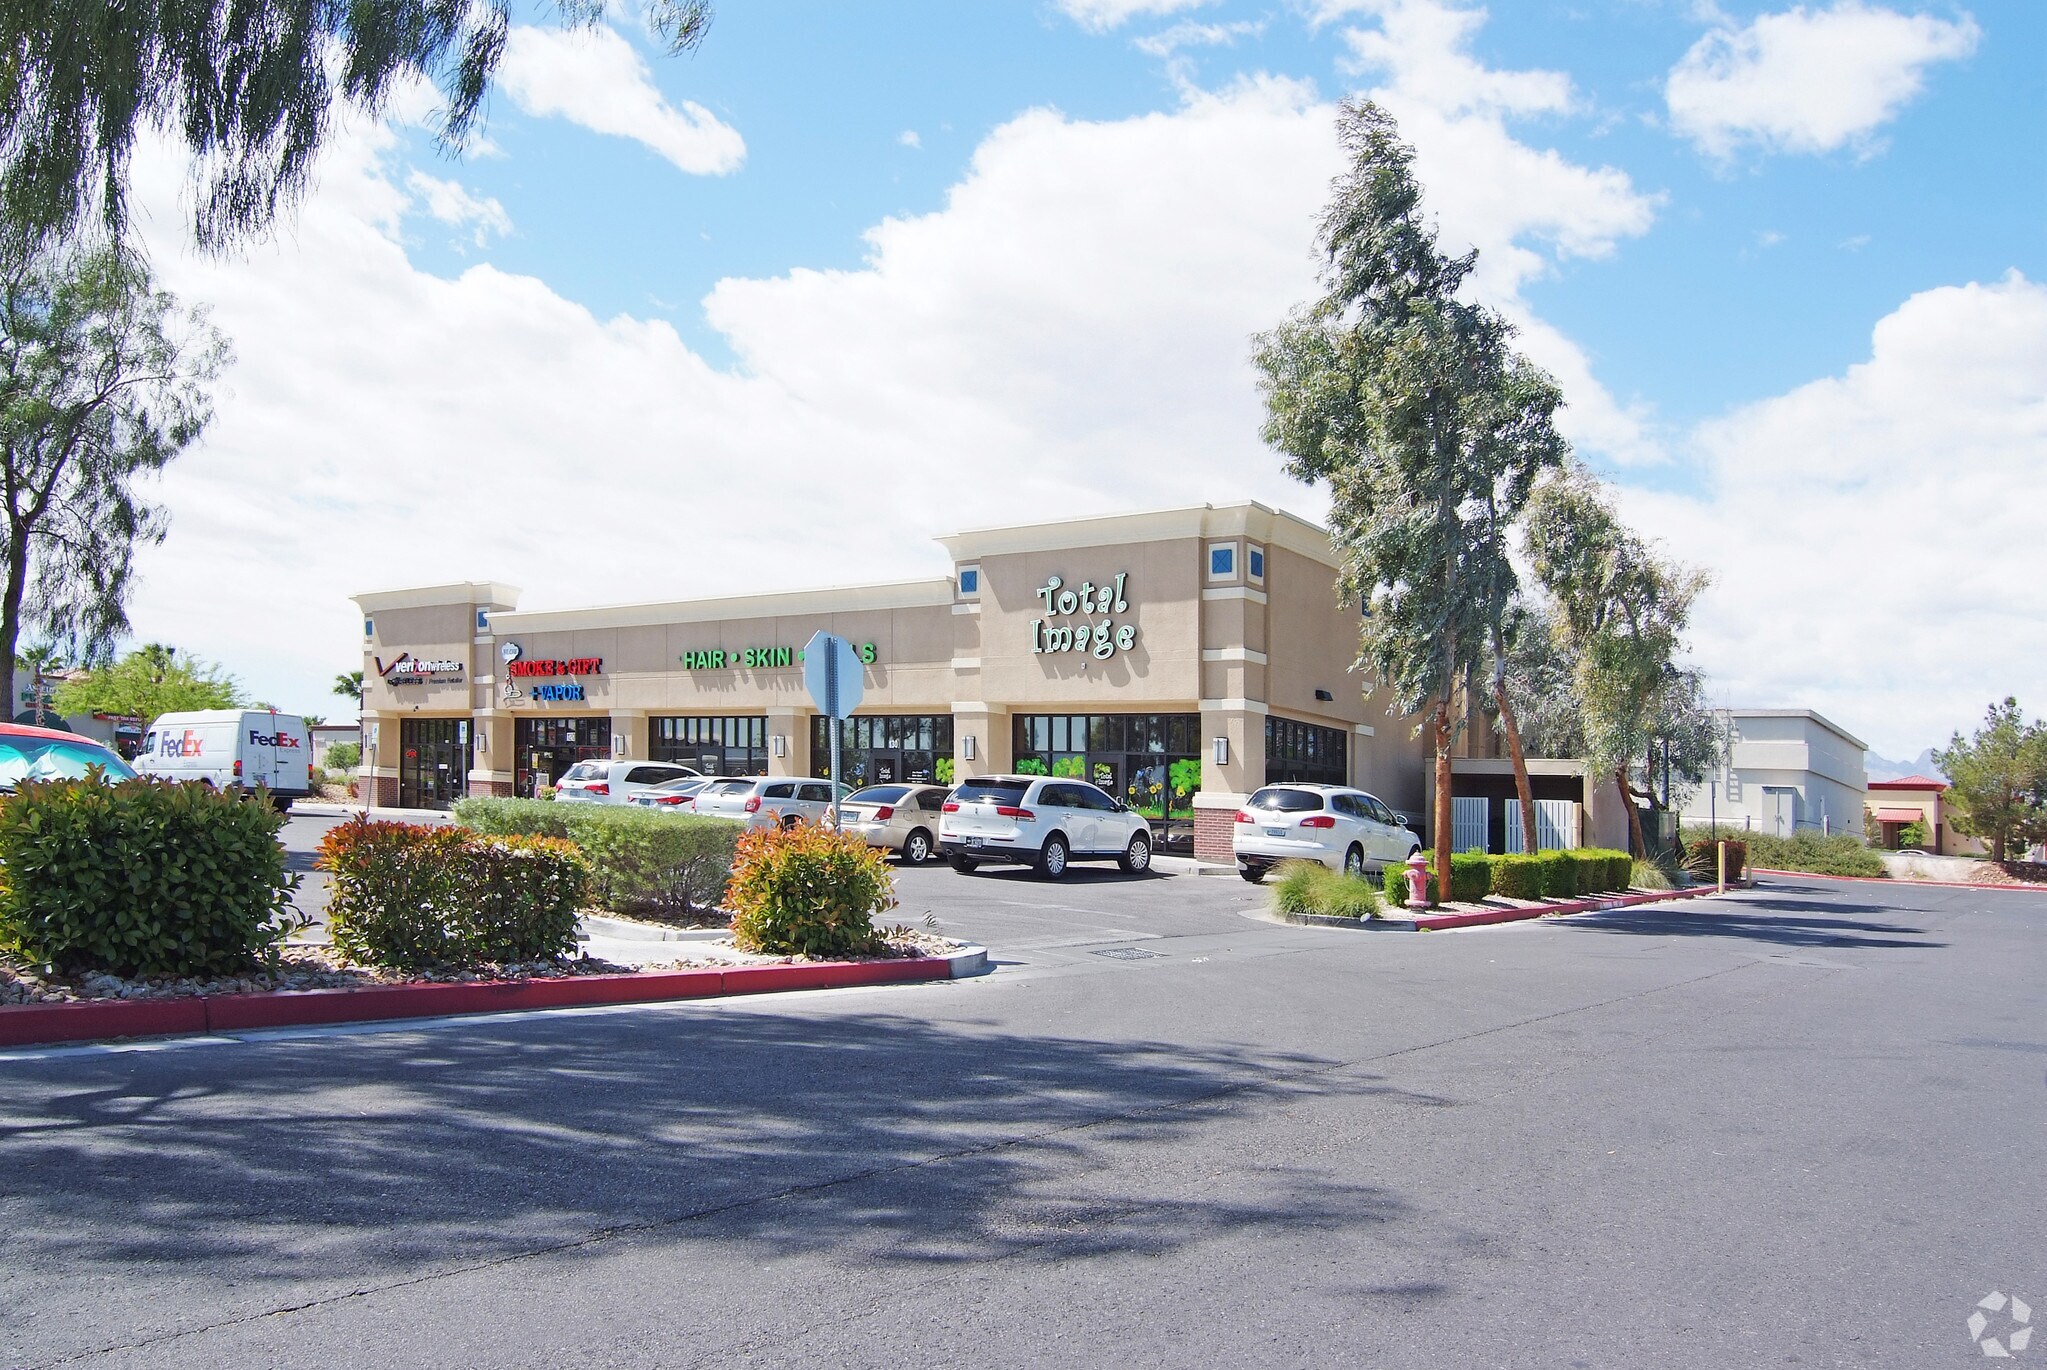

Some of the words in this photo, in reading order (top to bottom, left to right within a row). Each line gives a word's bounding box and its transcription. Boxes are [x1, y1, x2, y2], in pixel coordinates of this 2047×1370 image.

[1036, 572, 1128, 616] Total
[1029, 618, 1136, 660] Image
[510, 660, 556, 677] SMOKE
[556, 660, 567, 675] &
[567, 657, 602, 675] GIFT
[684, 650, 726, 669] HAIR
[744, 647, 794, 667] SKIN
[161, 729, 204, 757] FedEx
[250, 730, 300, 748] FedEx
